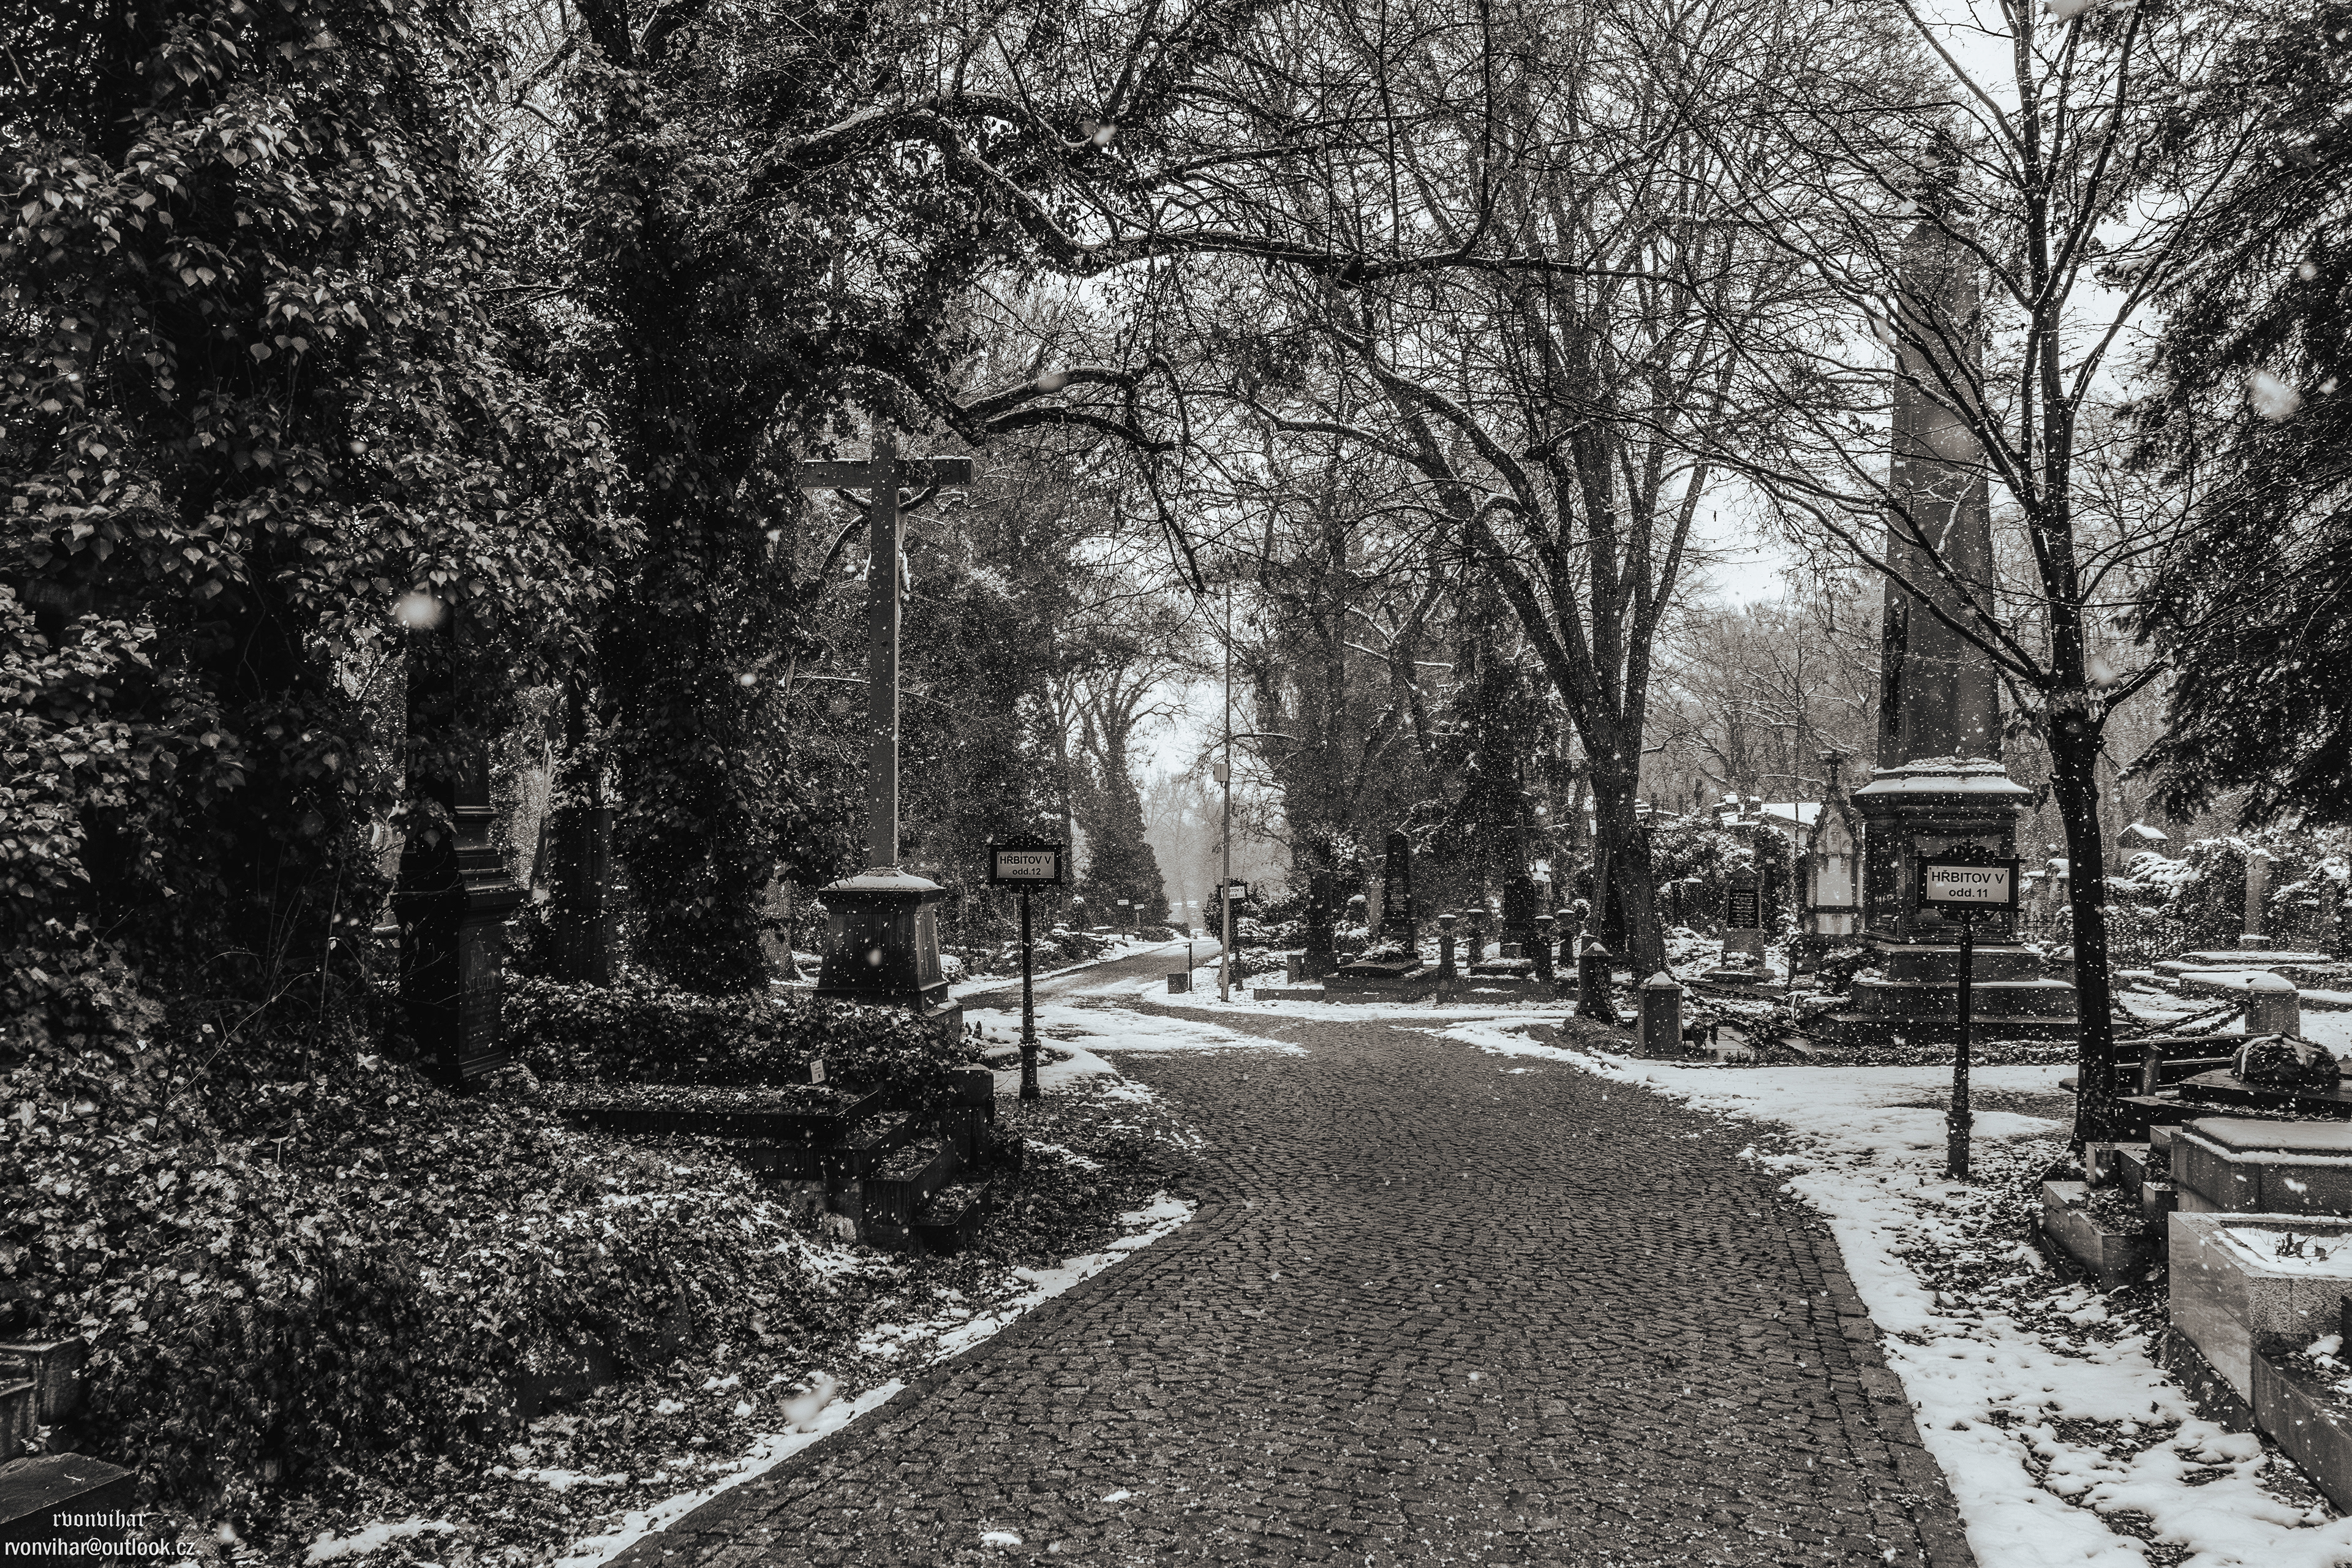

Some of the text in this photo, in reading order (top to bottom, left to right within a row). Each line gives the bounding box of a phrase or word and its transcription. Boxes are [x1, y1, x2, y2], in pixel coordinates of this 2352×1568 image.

[1000, 853, 1042, 864] HŘBITOV
[1931, 870, 2005, 884] HŘBITOV V
